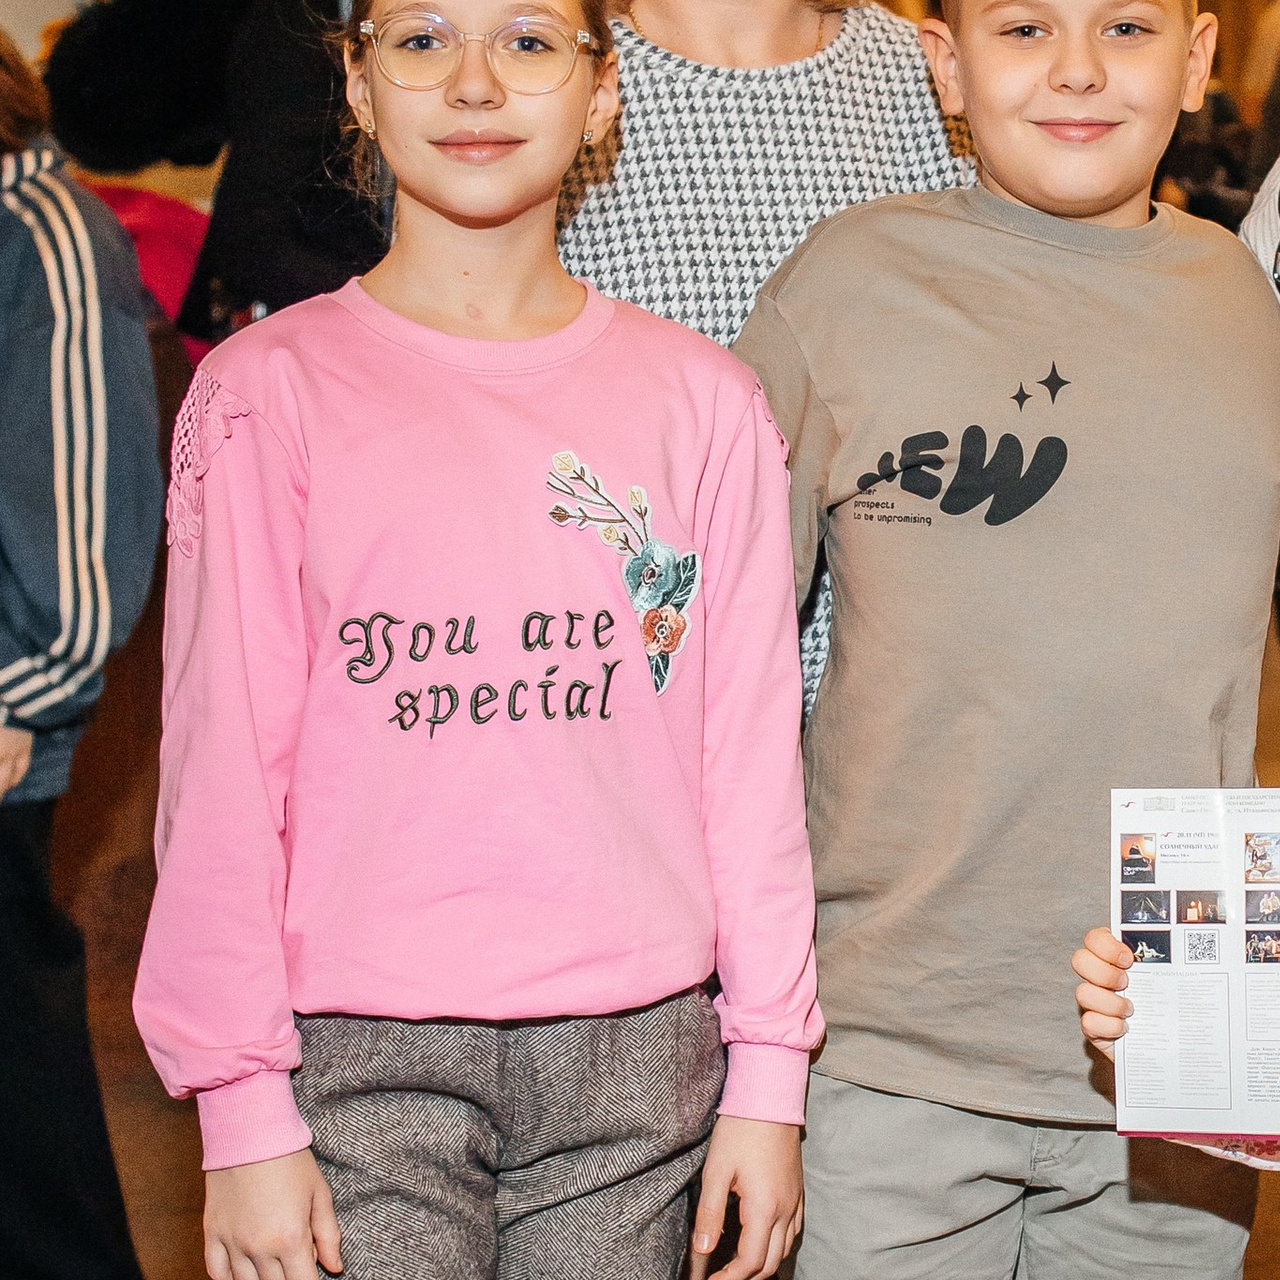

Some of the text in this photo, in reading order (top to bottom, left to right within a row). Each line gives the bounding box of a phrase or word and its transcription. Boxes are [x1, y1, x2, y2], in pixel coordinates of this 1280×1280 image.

[853, 500, 895, 511] prospects
[853, 512, 932, 527] to be unpromising
[338, 610, 616, 684] You are
[387, 659, 623, 740] special
